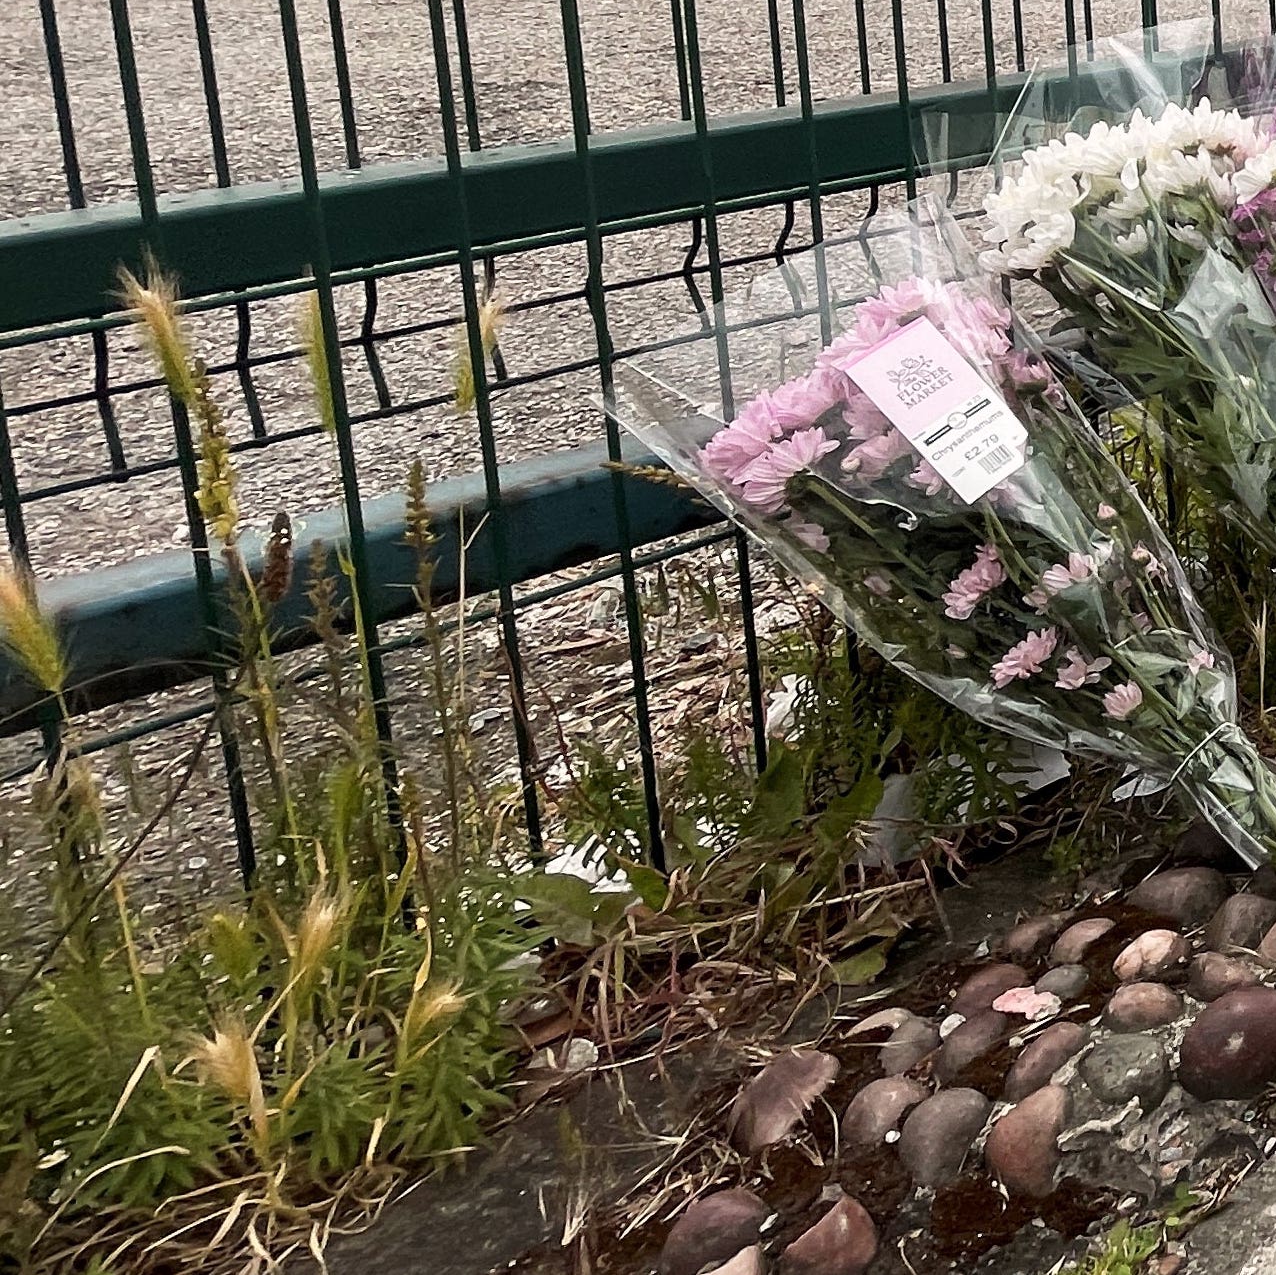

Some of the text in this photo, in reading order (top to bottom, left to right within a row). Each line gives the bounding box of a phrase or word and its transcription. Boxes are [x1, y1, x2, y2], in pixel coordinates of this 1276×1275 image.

[897, 366, 949, 402] FLOWER
[904, 372, 955, 410] MARKET
[931, 410, 1004, 461] Chrysanthemums
